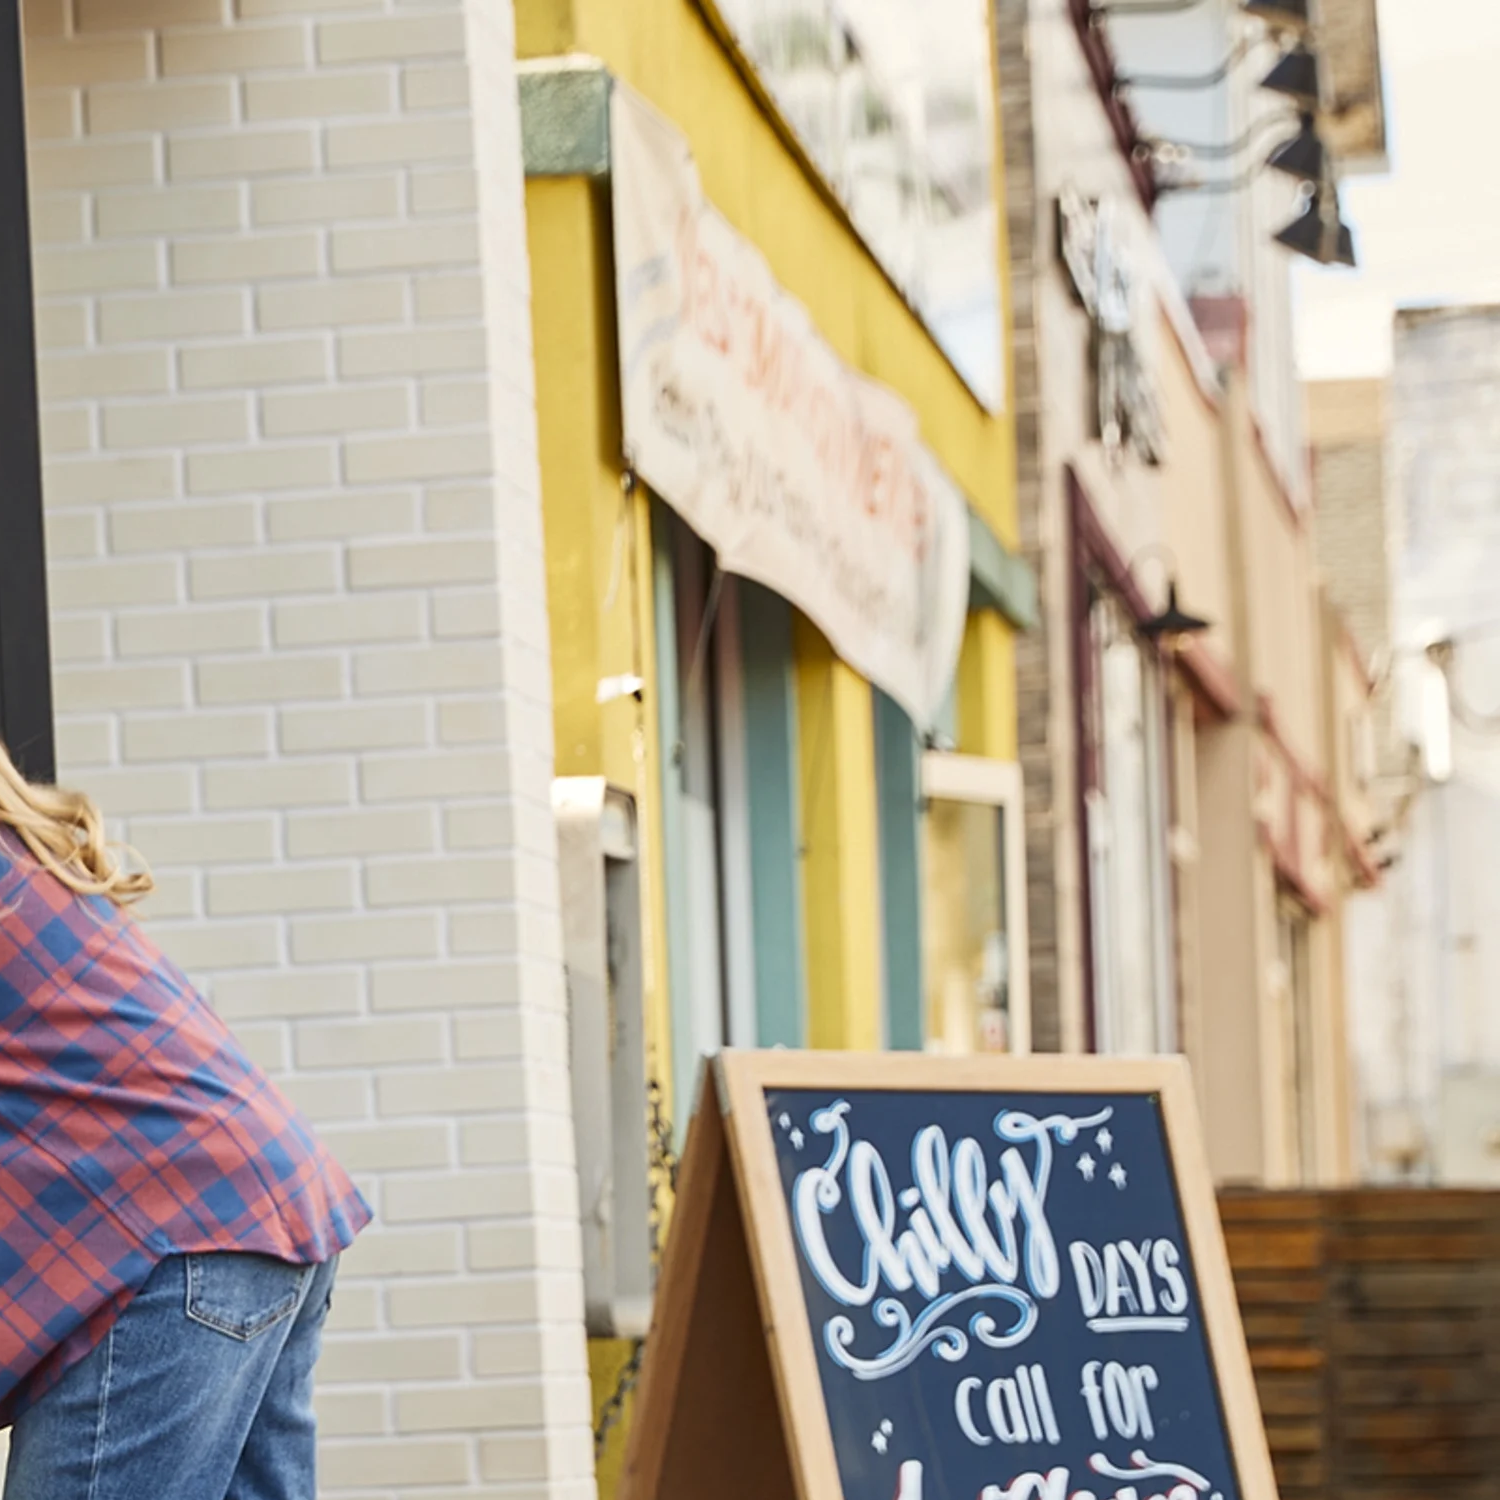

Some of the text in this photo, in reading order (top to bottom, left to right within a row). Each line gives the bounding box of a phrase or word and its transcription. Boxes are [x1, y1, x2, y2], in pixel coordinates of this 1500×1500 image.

[793, 1100, 1113, 1307] Chilly
[1069, 1238, 1189, 1318] DAYS
[955, 1361, 1159, 1446] call for
